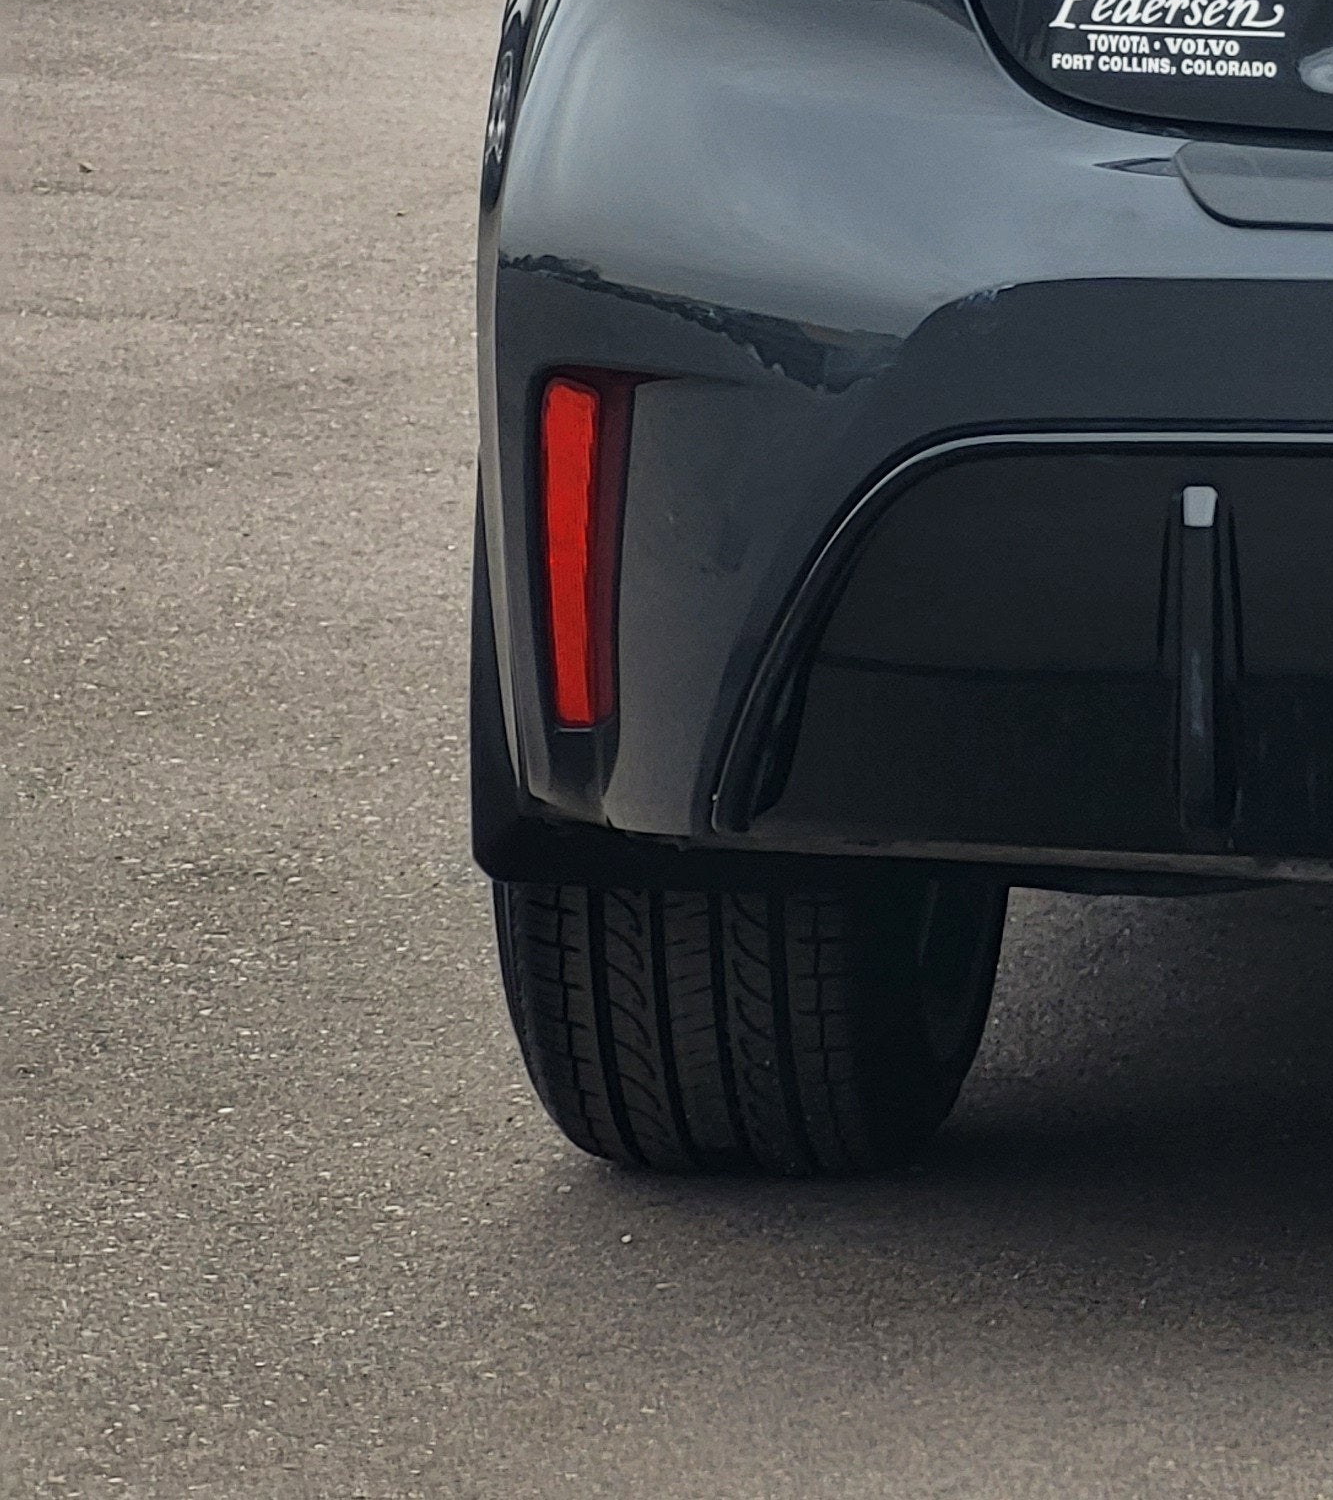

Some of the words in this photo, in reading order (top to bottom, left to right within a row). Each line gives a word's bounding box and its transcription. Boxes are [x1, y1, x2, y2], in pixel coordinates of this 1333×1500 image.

[1087, 33, 1150, 54] TOYOTA
[1164, 37, 1241, 57] VOLVO
[1051, 52, 1095, 71] FORT
[1098, 55, 1177, 76] COLLINS,
[1180, 58, 1278, 78] COLORADO
